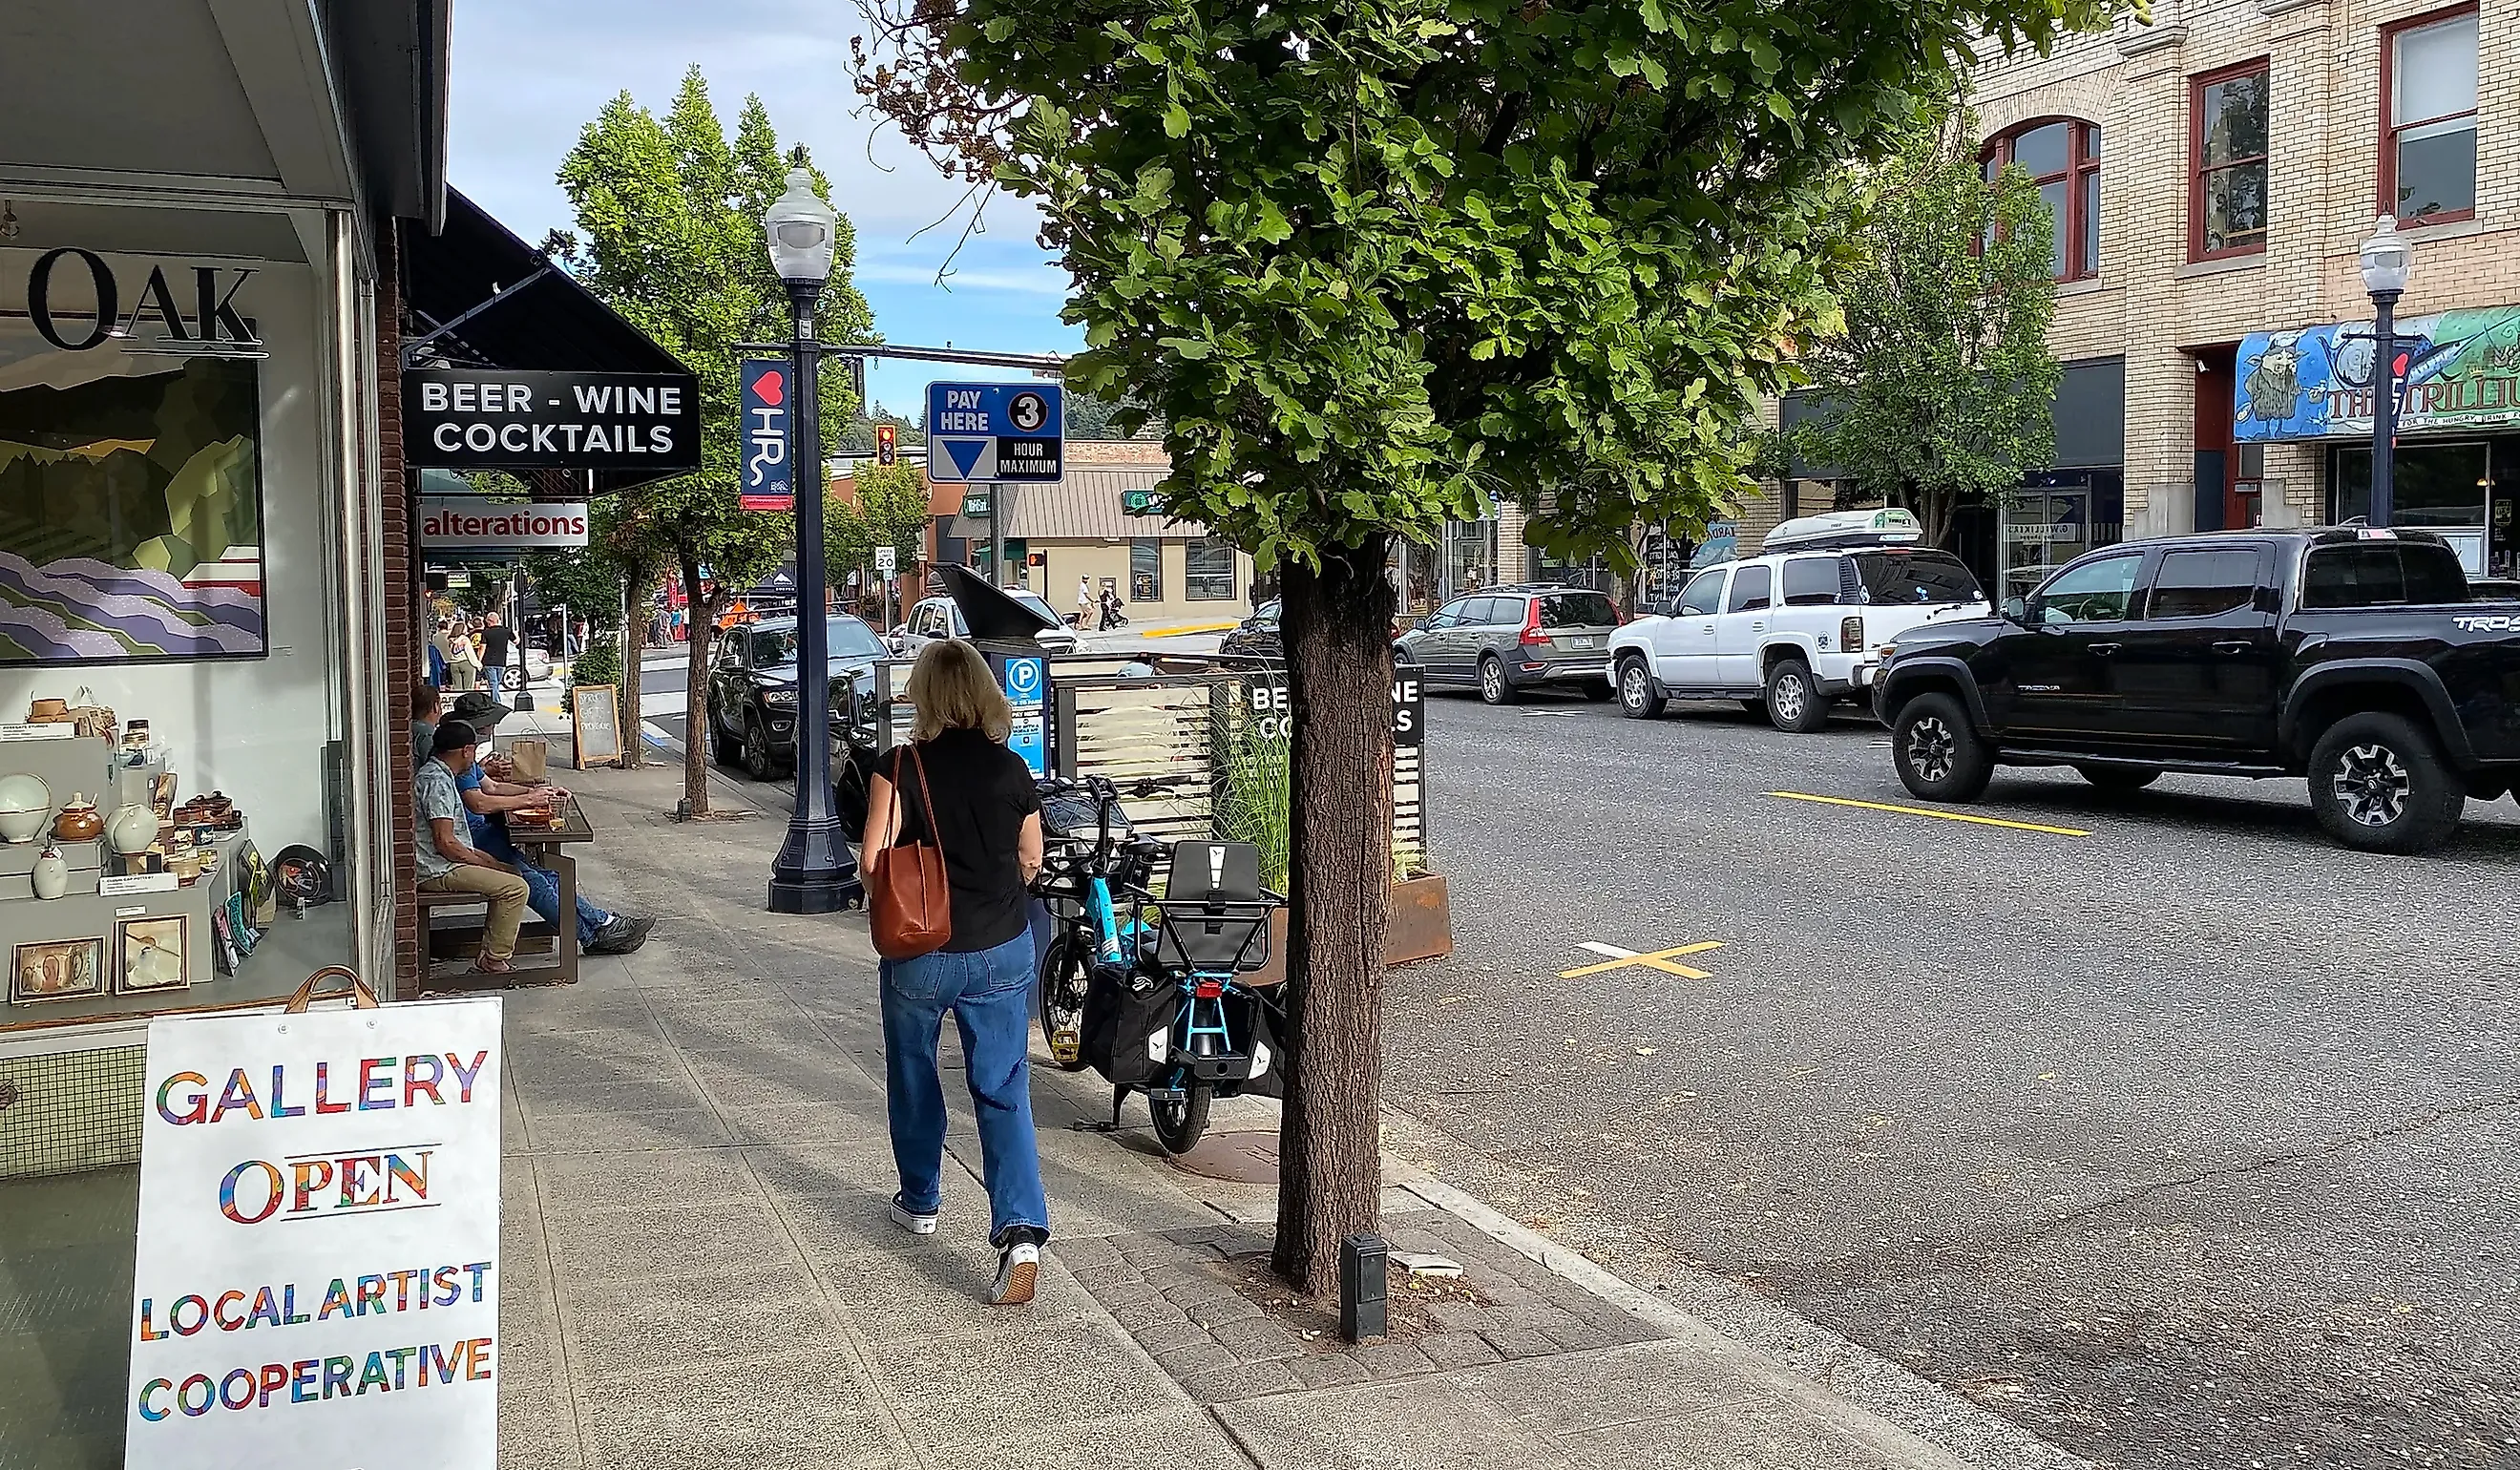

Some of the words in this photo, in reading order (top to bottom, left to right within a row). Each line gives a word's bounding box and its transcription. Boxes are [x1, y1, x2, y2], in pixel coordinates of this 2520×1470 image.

[28, 246, 261, 351] OAK
[422, 382, 533, 412] BEER
[573, 385, 682, 414] WINE
[947, 390, 981, 409] PAY
[1017, 396, 1040, 428] 3
[940, 412, 989, 431] HERE
[433, 422, 674, 453] COCKTAILS
[1014, 443, 1043, 456] HOUR
[1000, 460, 1057, 473] MAXIMUM
[423, 510, 585, 536] alterations
[877, 557, 893, 567] 20
[1252, 686, 1288, 710] BE
[156, 1050, 489, 1126] GALLERY
[219, 1150, 434, 1225] OPEN
[139, 1283, 310, 1342] LOCAL
[317, 1261, 493, 1323] ARTIST
[138, 1337, 493, 1422] COOPERATIVE
